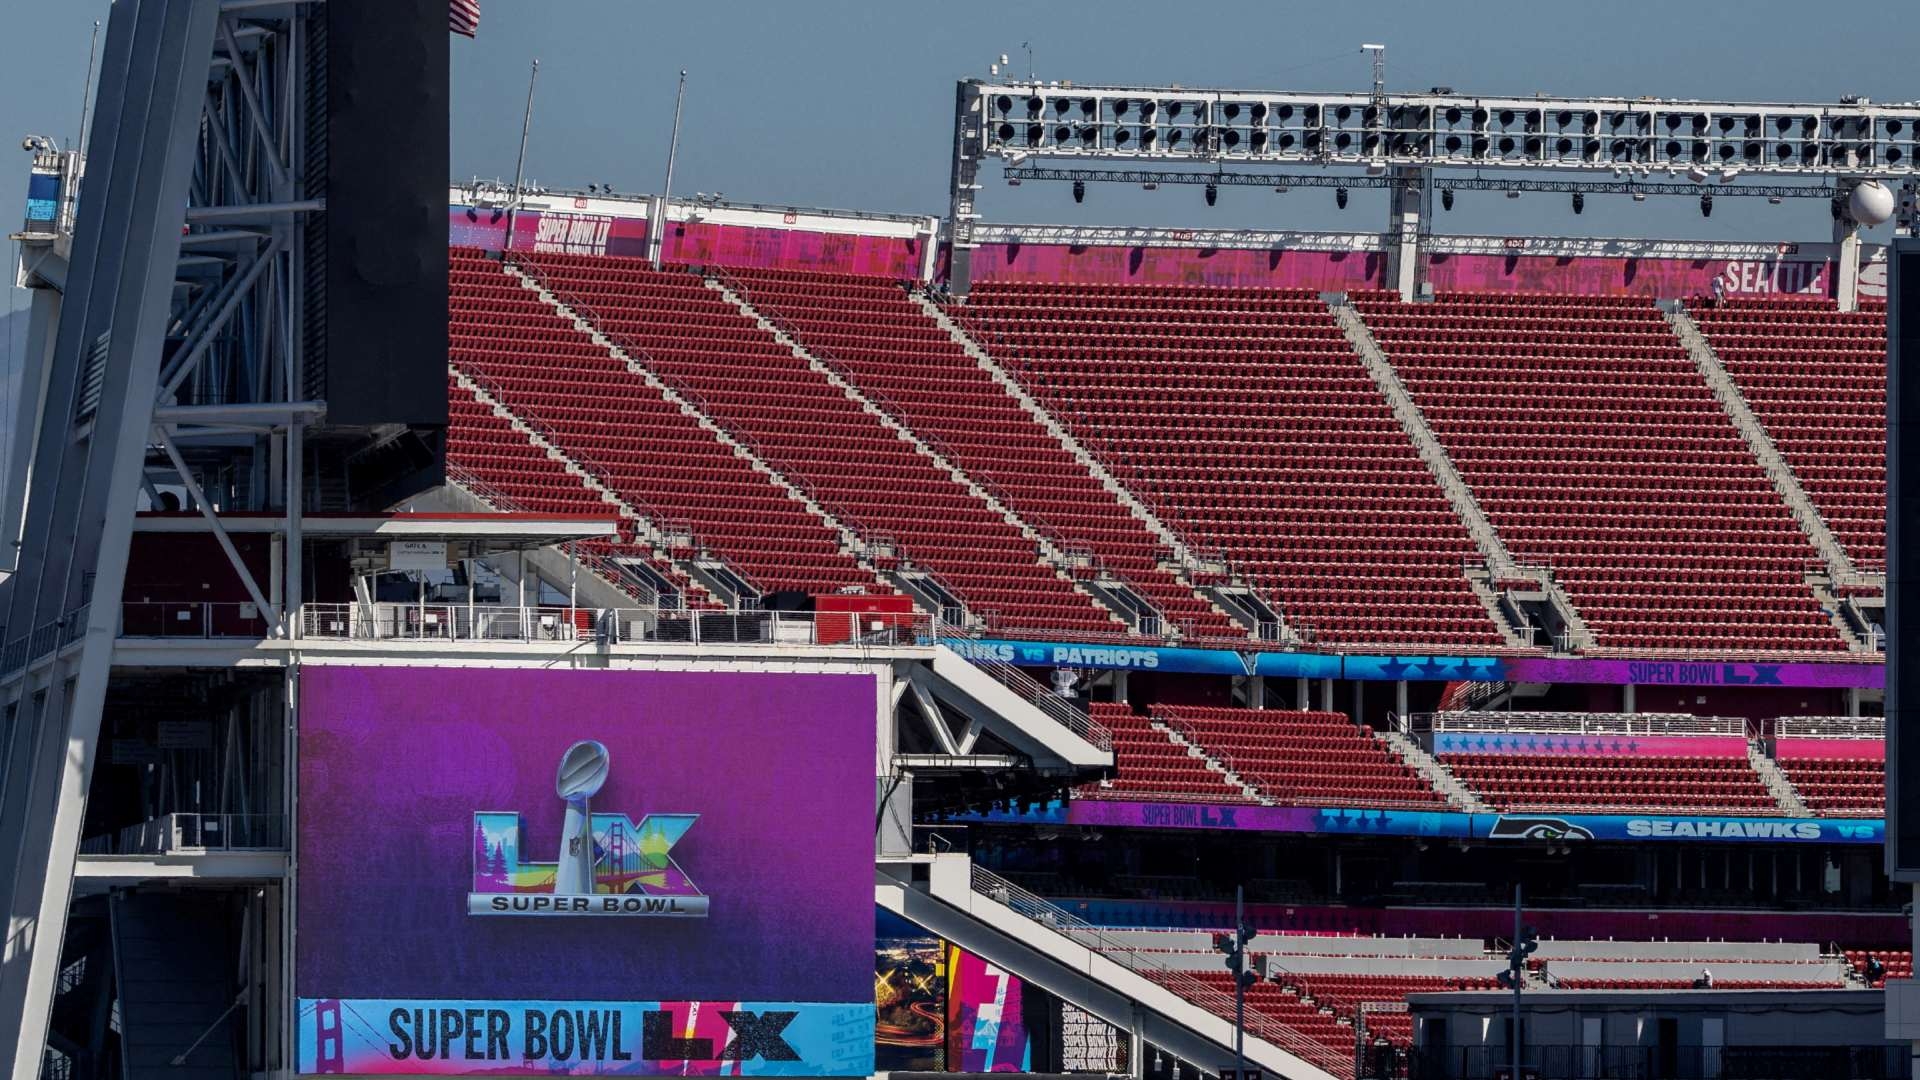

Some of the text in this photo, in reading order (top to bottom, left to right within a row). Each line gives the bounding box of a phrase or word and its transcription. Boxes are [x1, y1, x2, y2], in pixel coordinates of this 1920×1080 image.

[535, 219, 612, 246] SUPER BOWL LX
[1725, 261, 1823, 293] SEATTLE
[1053, 647, 1159, 668] PATRIOTS
[1628, 663, 1783, 685] SUPER BOWL LX
[1142, 805, 1237, 827] SUPER BOWL LX
[1627, 819, 1821, 839] SEAHAWKS
[491, 896, 685, 913] SUPER BOWL
[389, 1007, 801, 1062] SUPER BOWL LX
[1063, 1024, 1087, 1035] SUPER
[1087, 1024, 1107, 1035] BOWL
[1063, 1035, 1087, 1047] SUPER
[1087, 1035, 1108, 1047] BOWL
[1063, 1046, 1087, 1058] SUPER
[1087, 1046, 1108, 1058] BOWL
[1063, 1058, 1087, 1070] SUPER
[1087, 1058, 1108, 1070] BOWL
